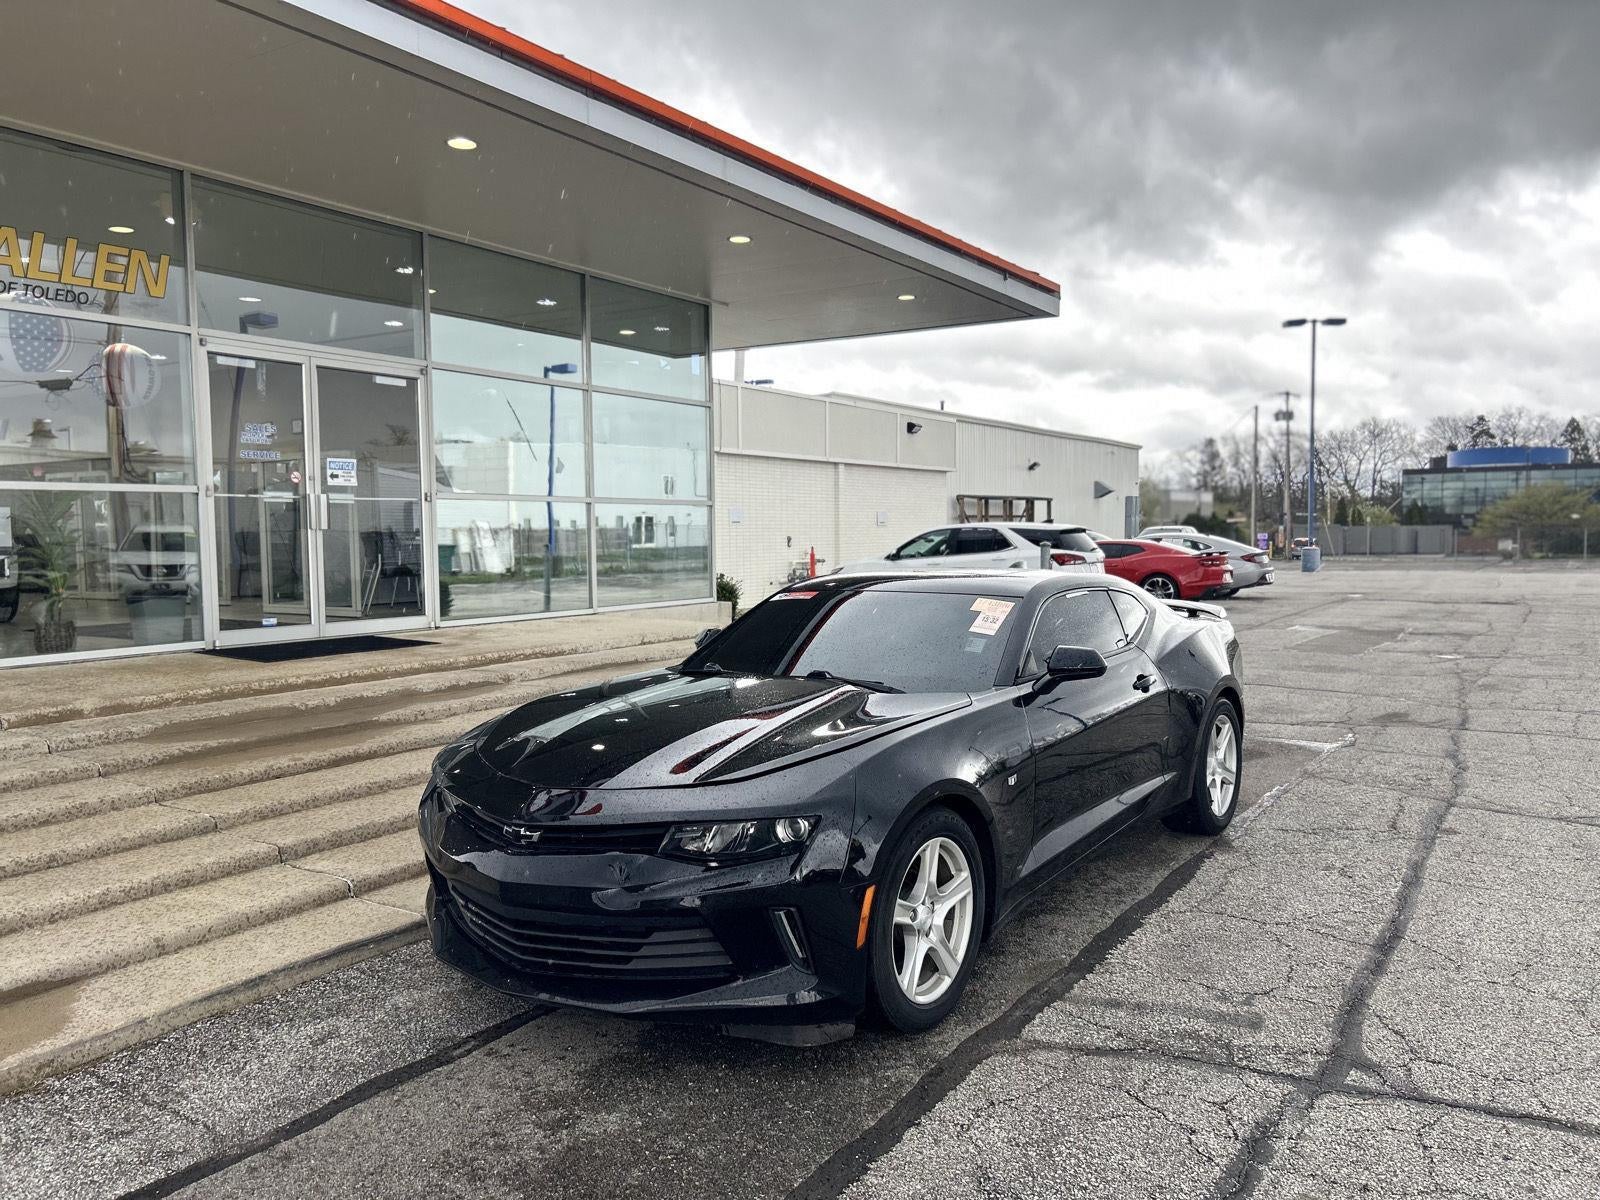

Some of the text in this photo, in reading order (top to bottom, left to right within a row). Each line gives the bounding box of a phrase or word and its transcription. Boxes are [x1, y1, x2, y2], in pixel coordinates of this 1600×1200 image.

[0, 226, 170, 299] ALLEN
[22, 283, 89, 305] TOLEDO
[246, 424, 277, 433] SALES
[240, 451, 280, 459] SERVICE
